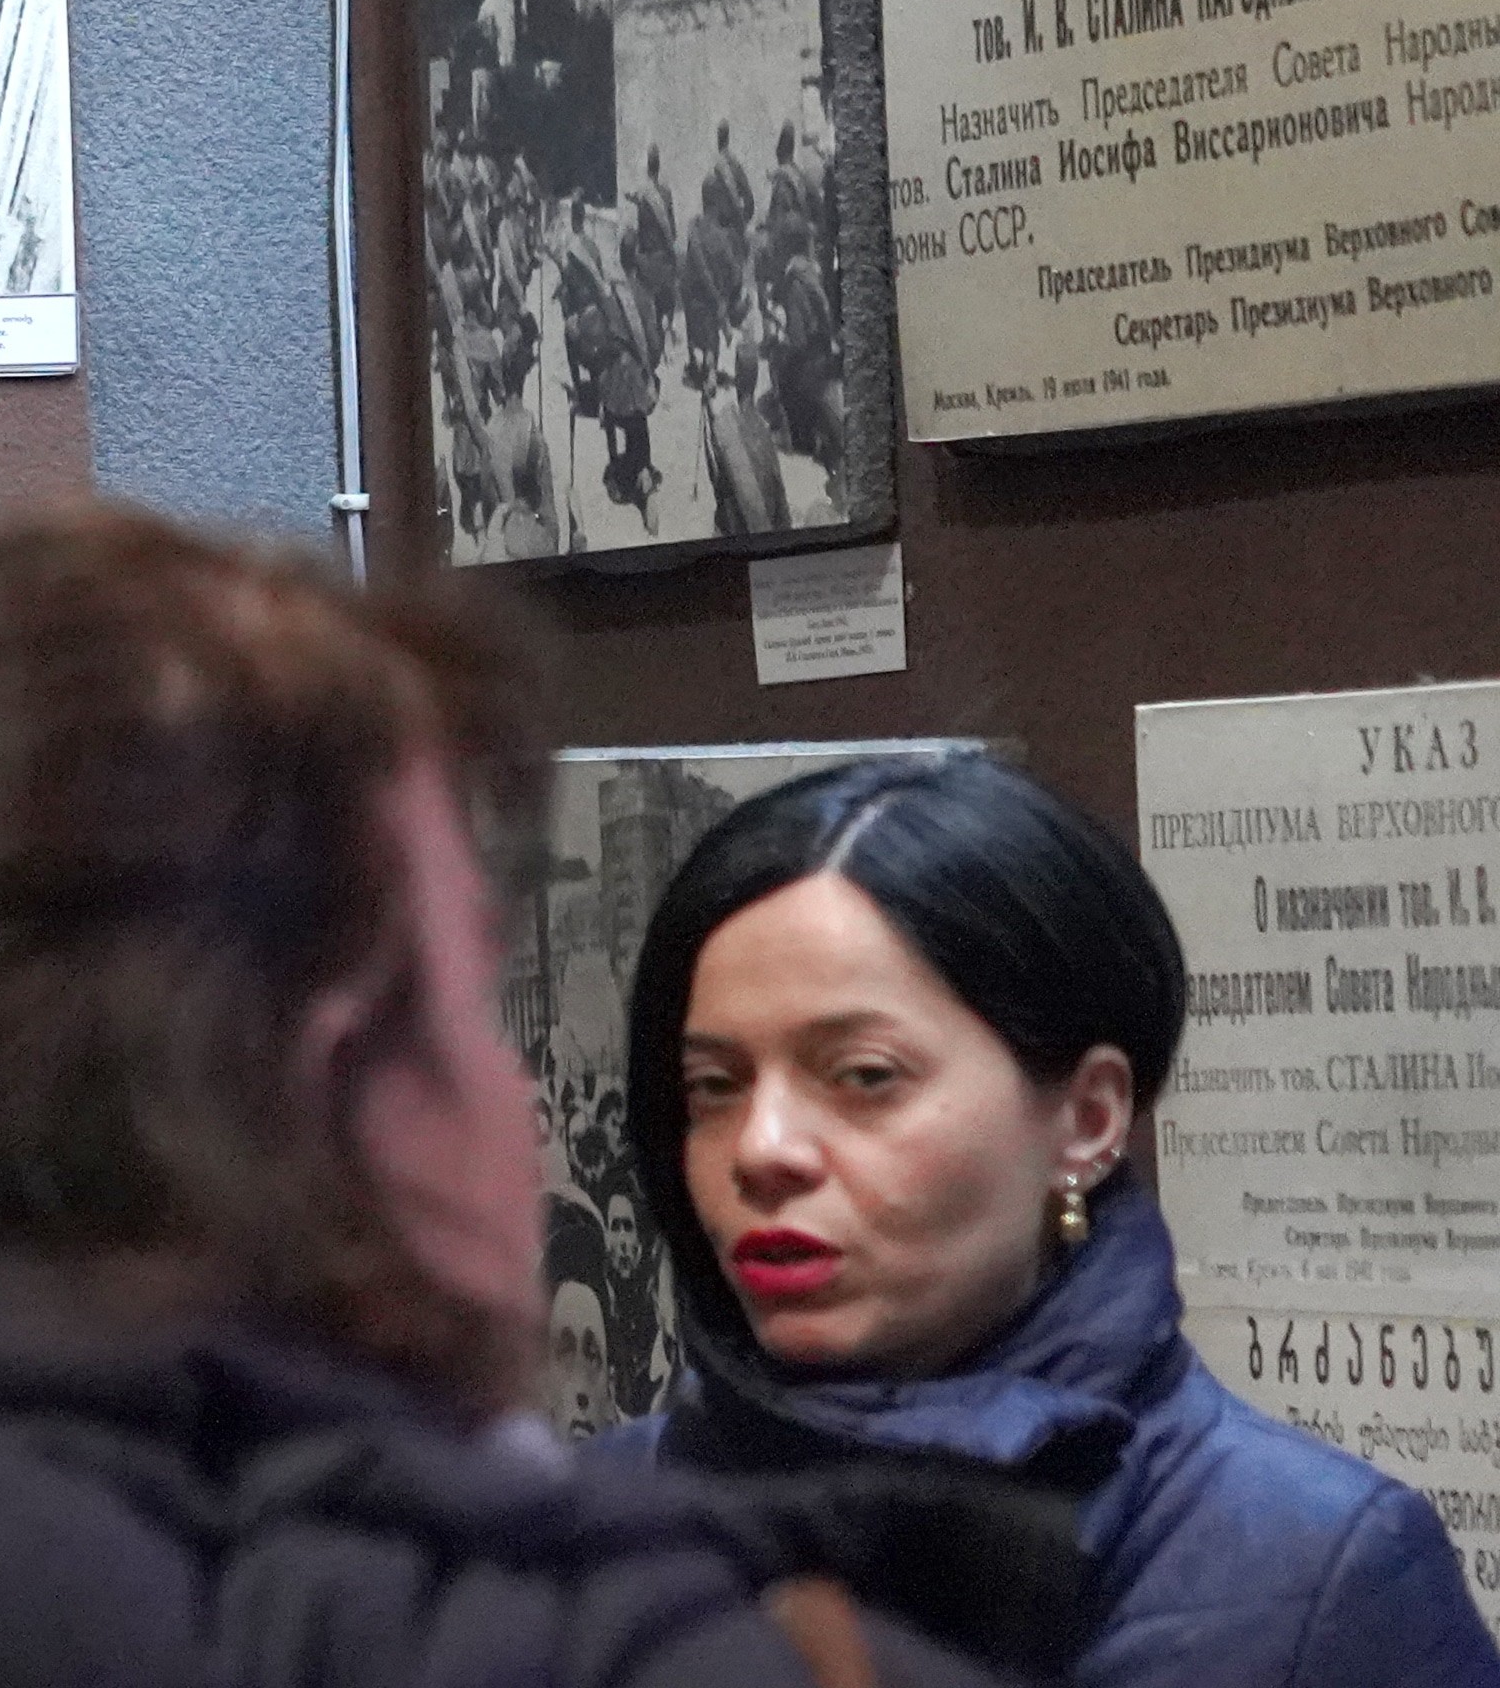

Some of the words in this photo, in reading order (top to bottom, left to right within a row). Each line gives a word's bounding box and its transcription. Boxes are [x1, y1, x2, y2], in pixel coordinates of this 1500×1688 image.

[940, 98, 1059, 145] Назначить
[1082, 63, 1248, 130] Председателя
[1273, 41, 1361, 88] Совета
[946, 155, 1042, 200] Сталина
[1058, 128, 1156, 184] Иосифа
[1173, 94, 1390, 164] Виссарионовича
[959, 204, 1034, 257] СССР.
[1038, 256, 1172, 304] Председатель
[1186, 236, 1310, 283] Президиума
[1324, 212, 1447, 261] Верховного
[1114, 310, 1219, 351] Секретарь
[1231, 289, 1356, 338] Президиума
[1358, 719, 1479, 775] УКАЗ
[1151, 806, 1322, 853] ПРЕЗИДИУМА
[1255, 874, 1268, 933] О
[1326, 953, 1394, 1013] Совета
[1326, 1053, 1459, 1092] СТАЛИНА
[1316, 1117, 1390, 1156] Совета
[1248, 1315, 1493, 1393] ბრძანებუ
